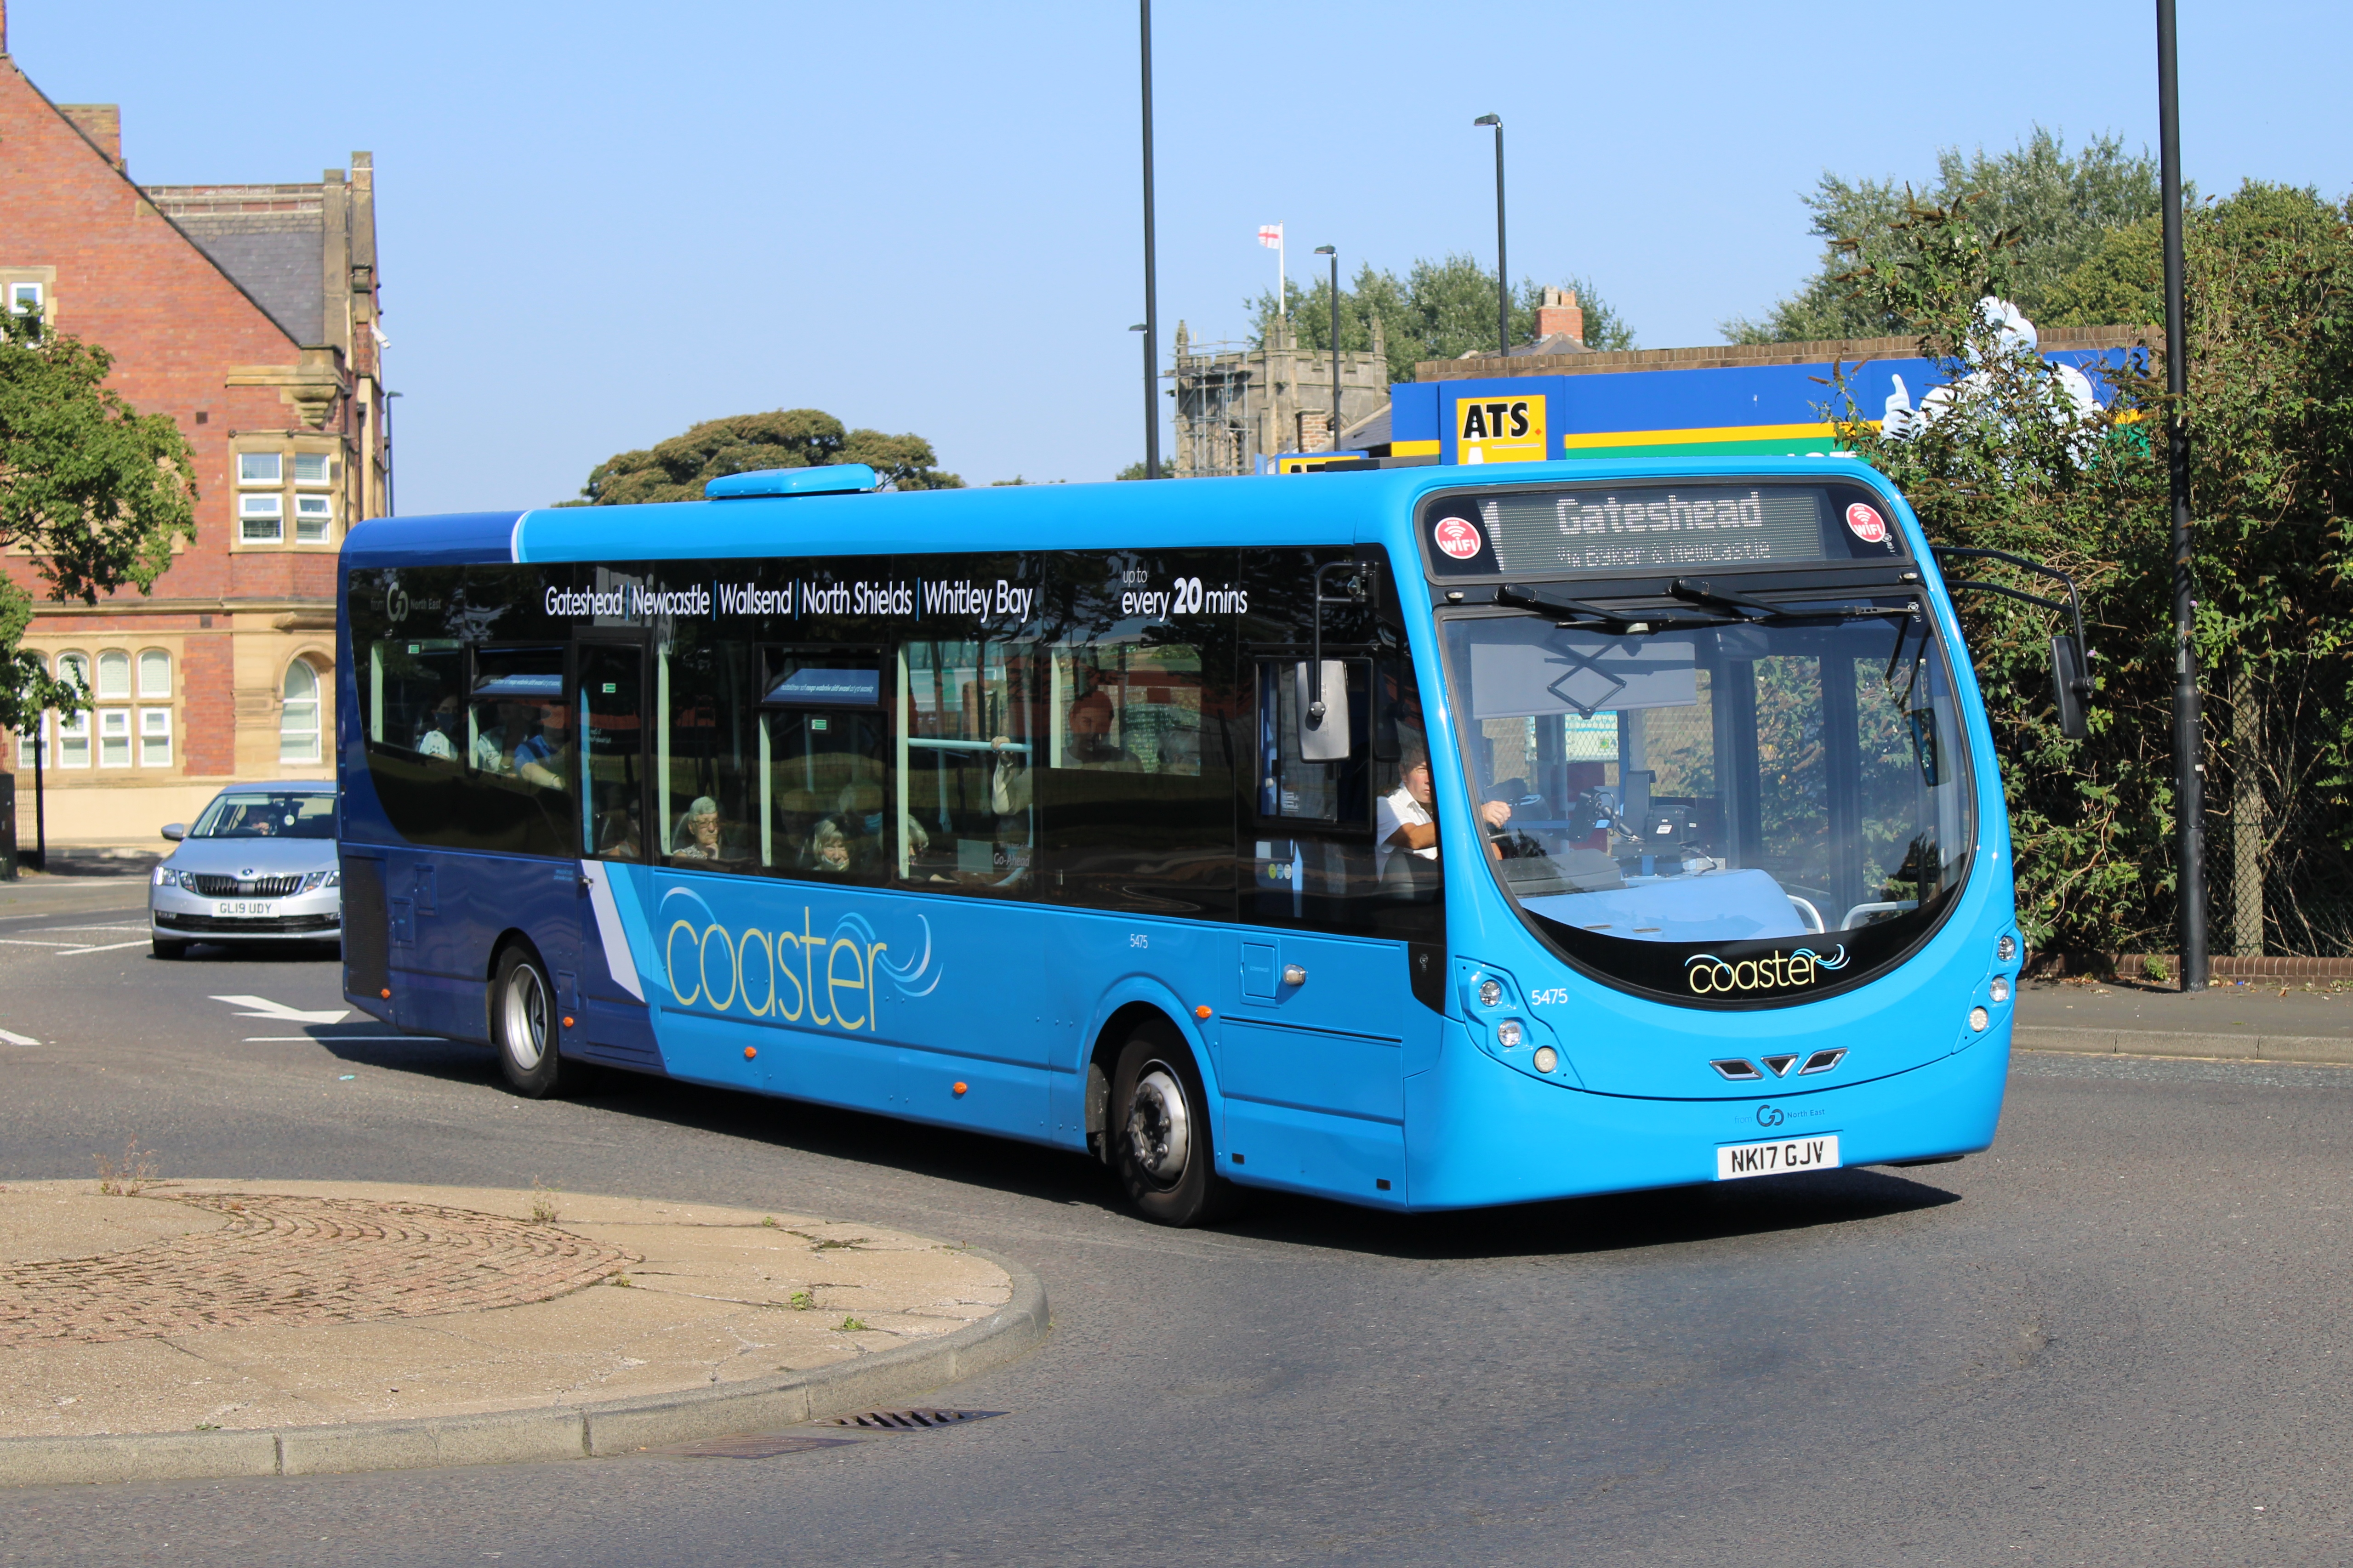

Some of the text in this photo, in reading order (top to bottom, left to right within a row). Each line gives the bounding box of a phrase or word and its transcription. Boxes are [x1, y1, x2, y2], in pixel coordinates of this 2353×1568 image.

[1463, 402, 1529, 440] ATS
[1556, 491, 1763, 535] Gateshead
[1481, 501, 1505, 571] 1
[1123, 567, 1148, 587] up to
[410, 599, 427, 609] North
[428, 598, 441, 609] East
[545, 579, 1033, 624] Gateshead Newcastle Wallsend North Shields Whitley Bay
[1122, 577, 1248, 622] every 20 mins
[994, 852, 1030, 867] Go-Ahead
[220, 903, 272, 914] GL19 UDY
[1130, 933, 1148, 949] 5475
[667, 906, 887, 1031] coaster
[1689, 950, 1822, 994] coaster
[1532, 988, 1568, 1006] 5475
[1734, 1115, 1752, 1124] from
[1787, 1110, 1807, 1119] North
[1810, 1108, 1825, 1117] East
[1732, 1141, 1824, 1173] NK17 GJV
